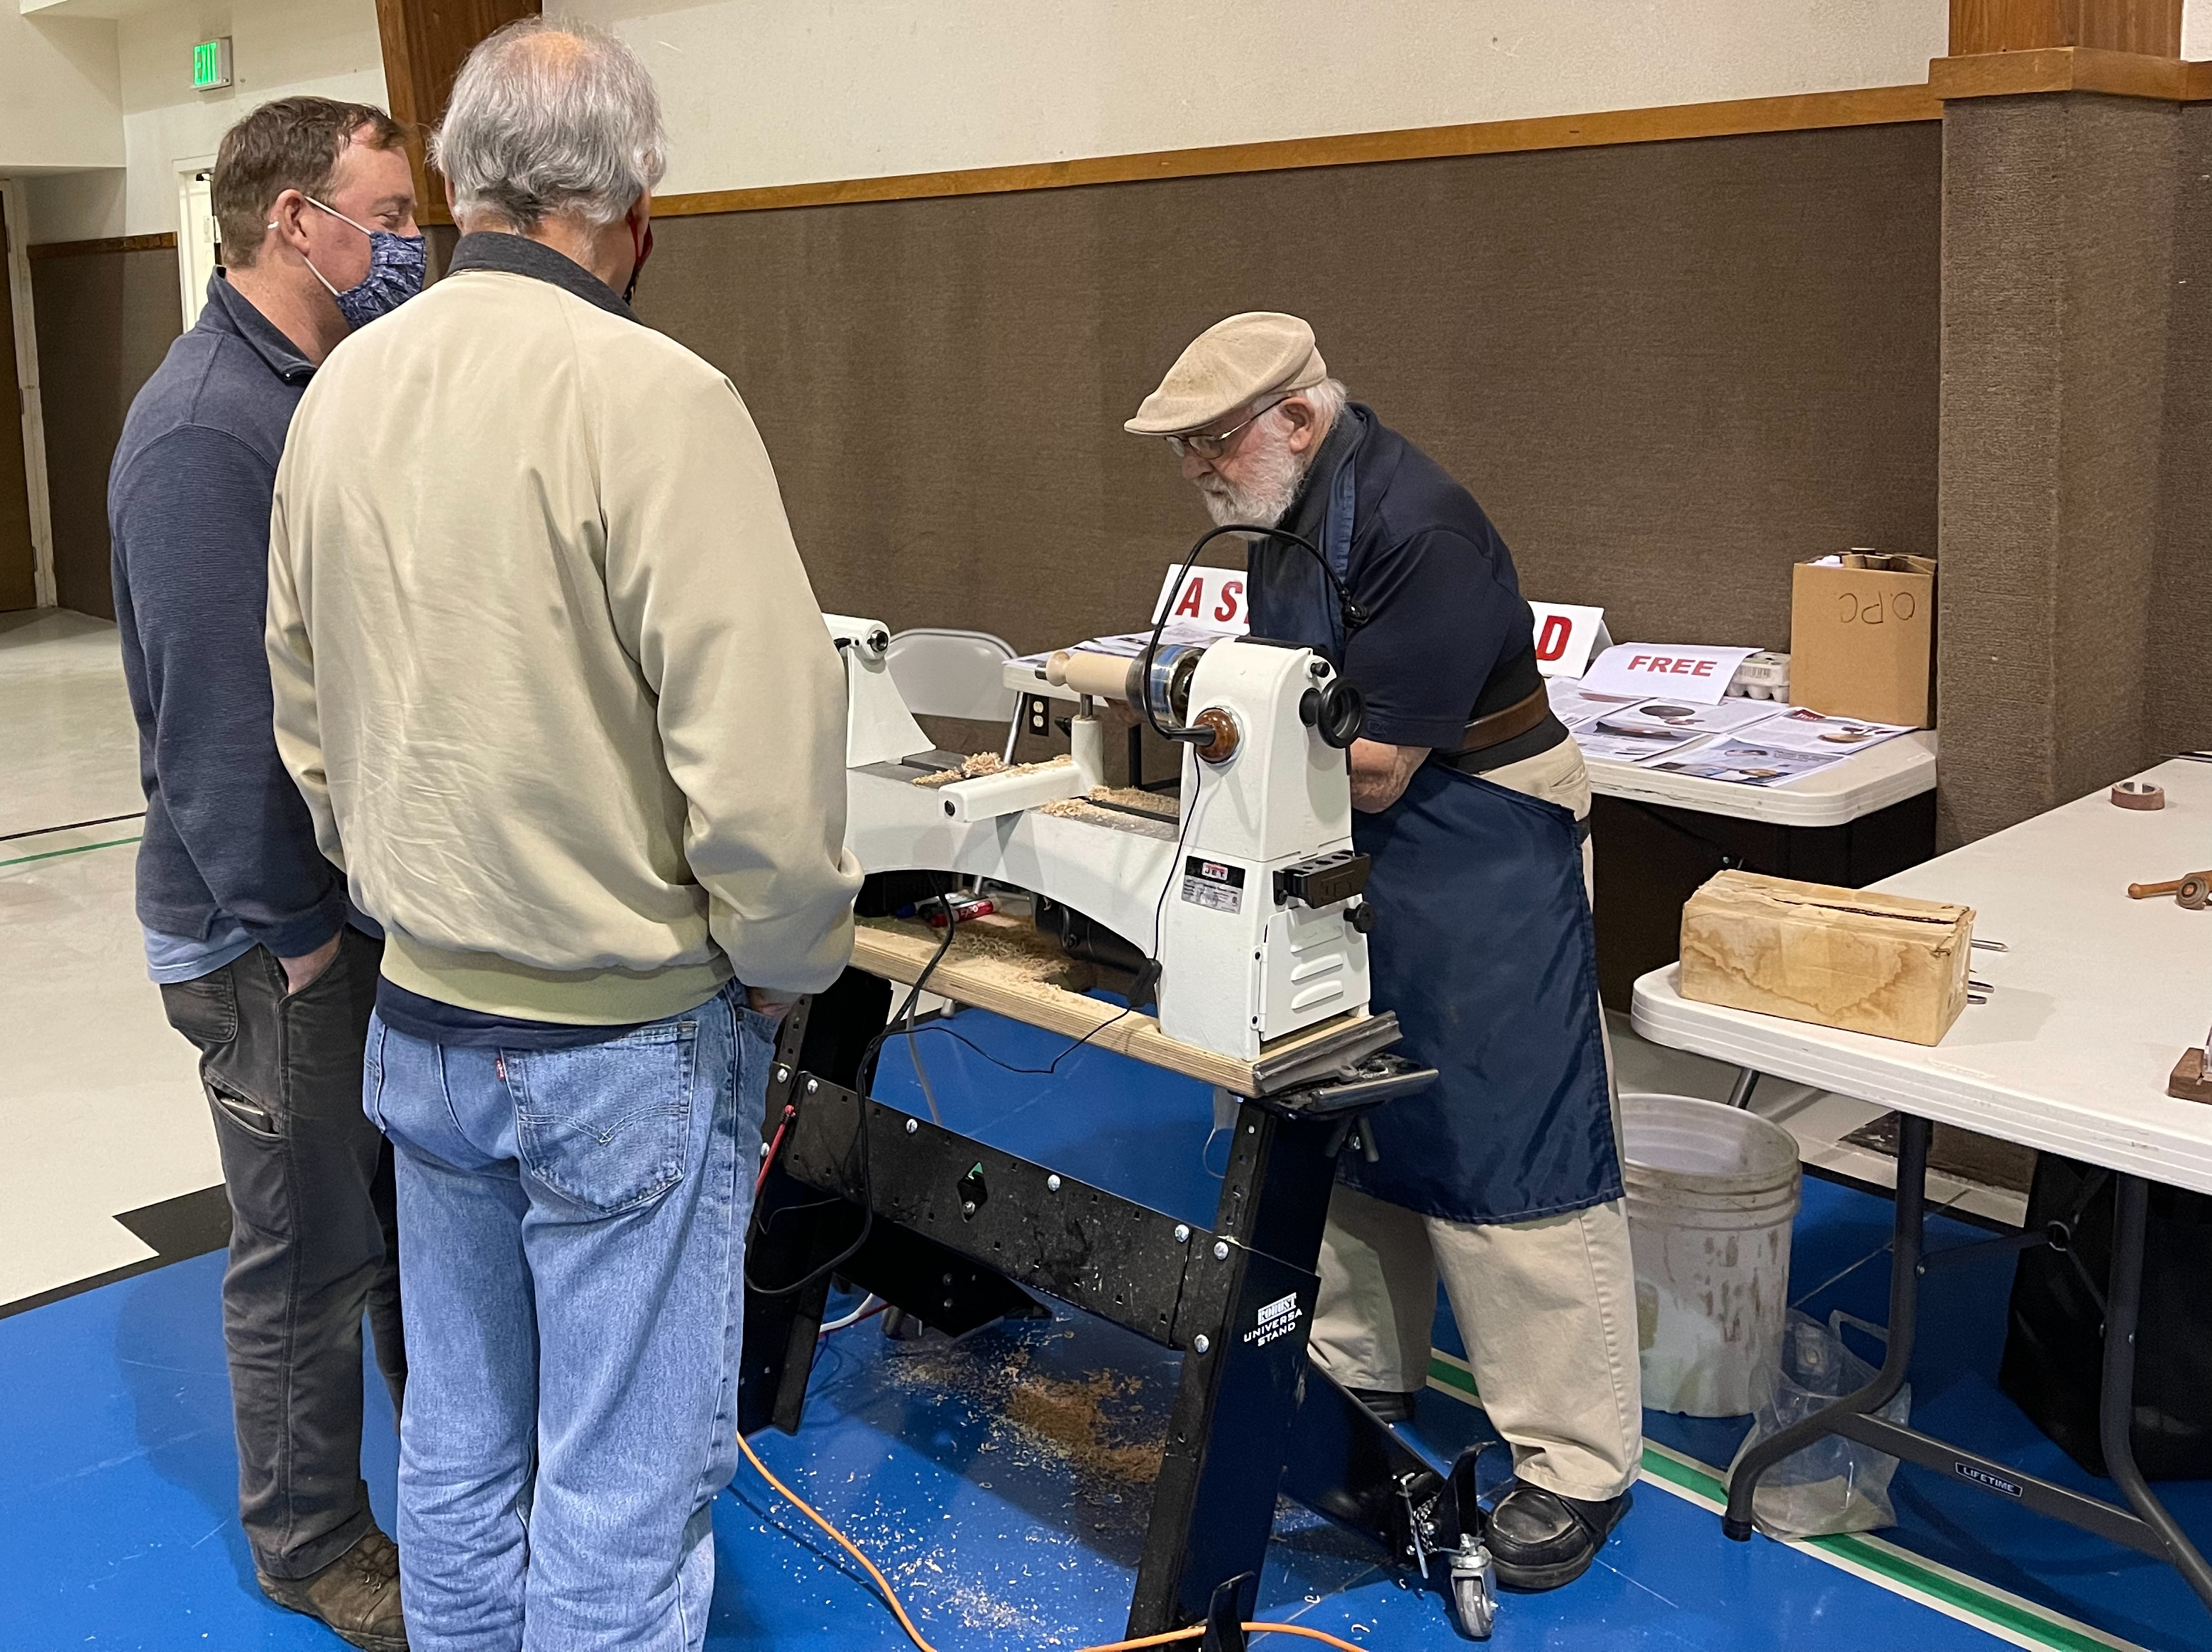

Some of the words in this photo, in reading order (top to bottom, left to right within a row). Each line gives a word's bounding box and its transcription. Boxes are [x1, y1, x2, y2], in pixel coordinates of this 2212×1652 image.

[194, 42, 217, 85] EXIT
[1627, 655, 1718, 677] FREE
[1204, 866, 1226, 879] JET
[1258, 1321, 1296, 1347] STAND
[1963, 1467, 2015, 1493] LIFETIME
